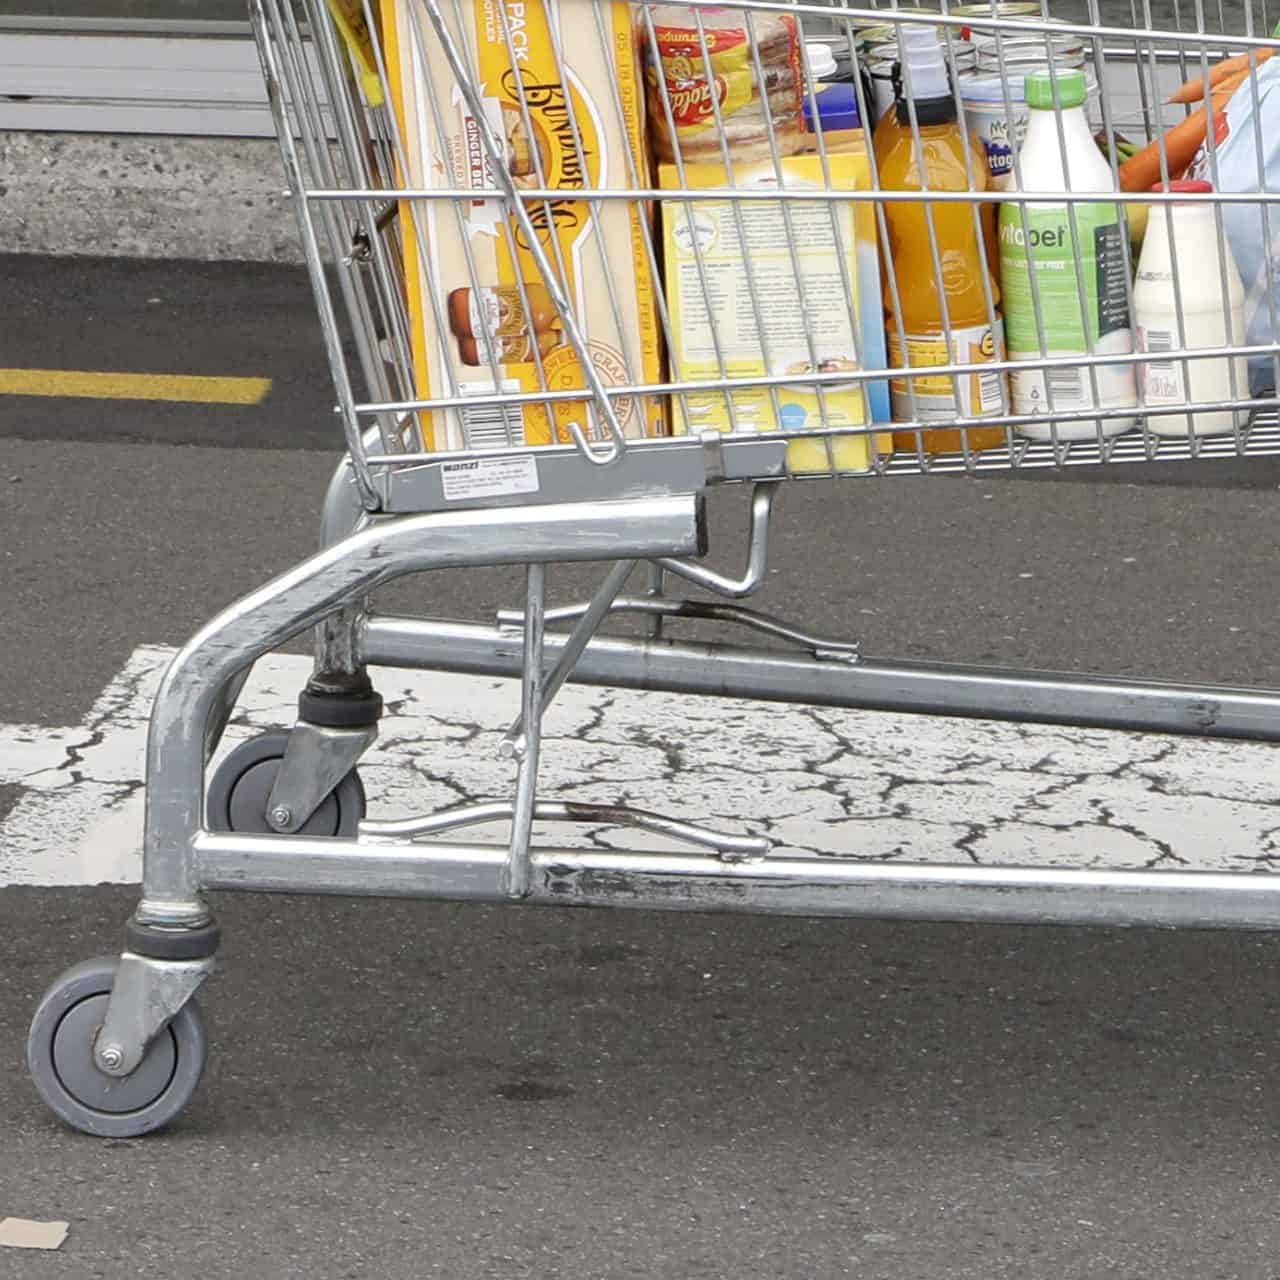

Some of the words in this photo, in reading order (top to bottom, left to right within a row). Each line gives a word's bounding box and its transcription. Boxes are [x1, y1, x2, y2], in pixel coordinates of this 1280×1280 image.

[507, 2, 529, 61] PACK
[466, 120, 482, 167] GINGER
[471, 169, 484, 192] BE
[593, 350, 627, 387] CRAF
